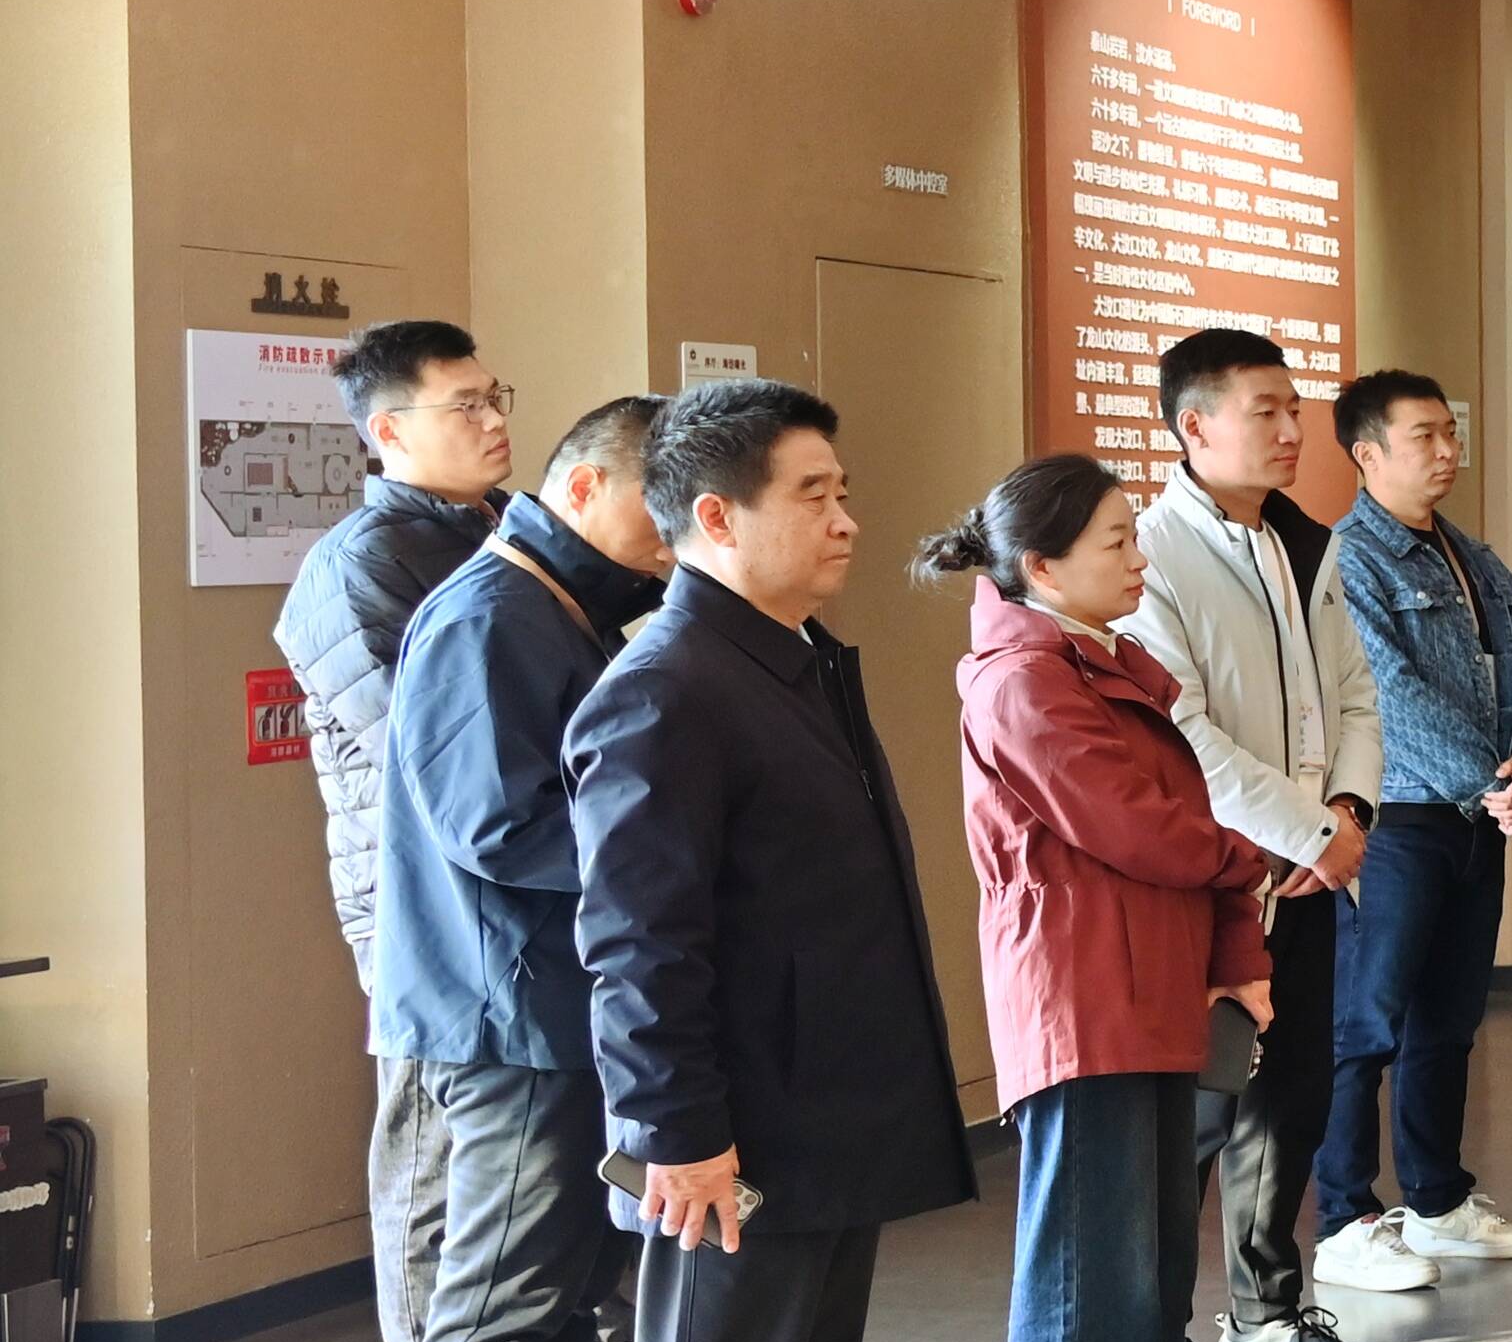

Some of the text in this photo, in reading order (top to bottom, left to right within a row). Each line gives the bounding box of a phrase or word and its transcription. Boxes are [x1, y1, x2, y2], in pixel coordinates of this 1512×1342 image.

[259, 345, 348, 366] 消防疏散示意
